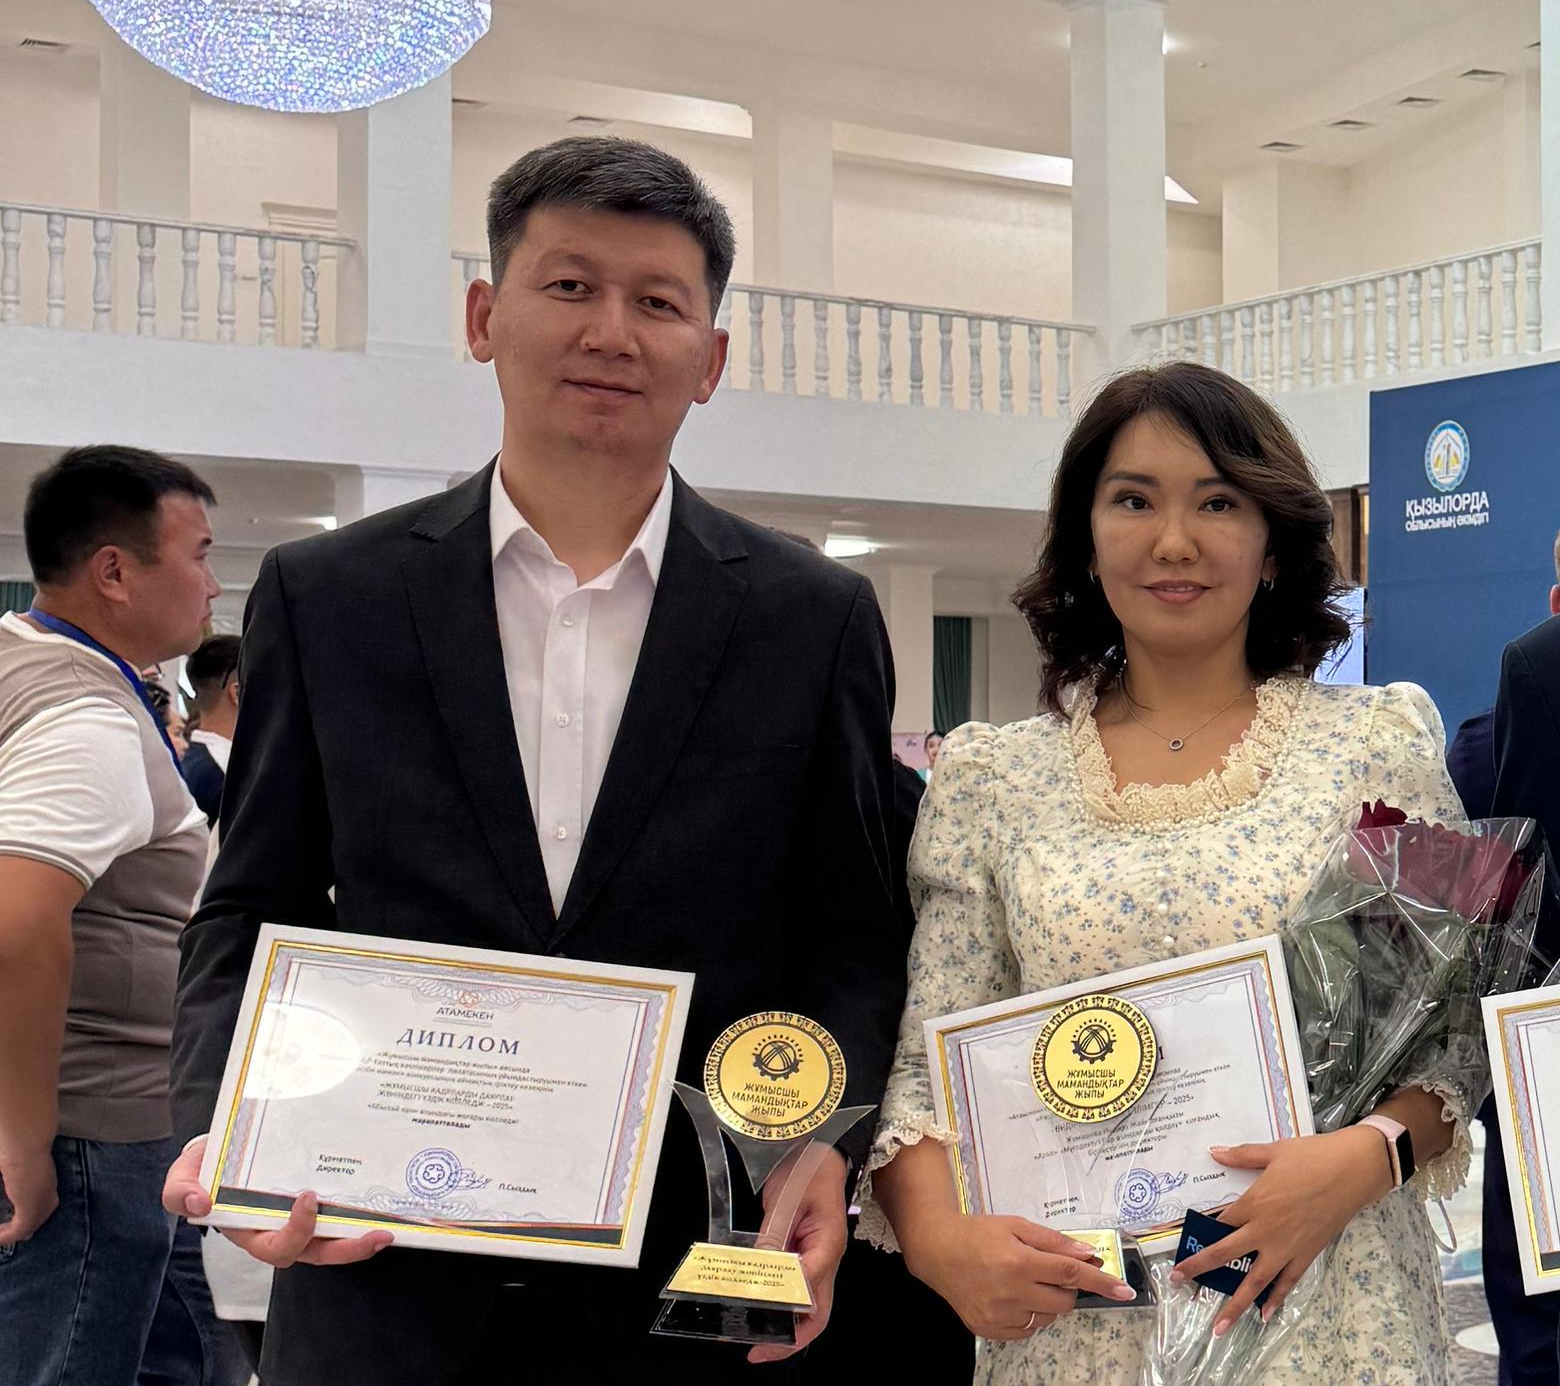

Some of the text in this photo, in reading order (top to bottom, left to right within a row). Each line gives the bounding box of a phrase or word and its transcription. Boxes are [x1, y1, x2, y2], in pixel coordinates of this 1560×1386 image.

[1405, 491, 1489, 521] ҚЫЗЫЛОРДА
[436, 1007, 494, 1020] АТАМЕКЕН
[397, 1027, 519, 1058] ДИПЛОМ
[1056, 1079, 1125, 1089] МАМАНДЫҚТАР
[732, 1091, 808, 1110] МАМАНДЫҚТАР
[1074, 1090, 1105, 1099] ЖЫЛЫ
[751, 1104, 786, 1117] ЖЫЛЫ
